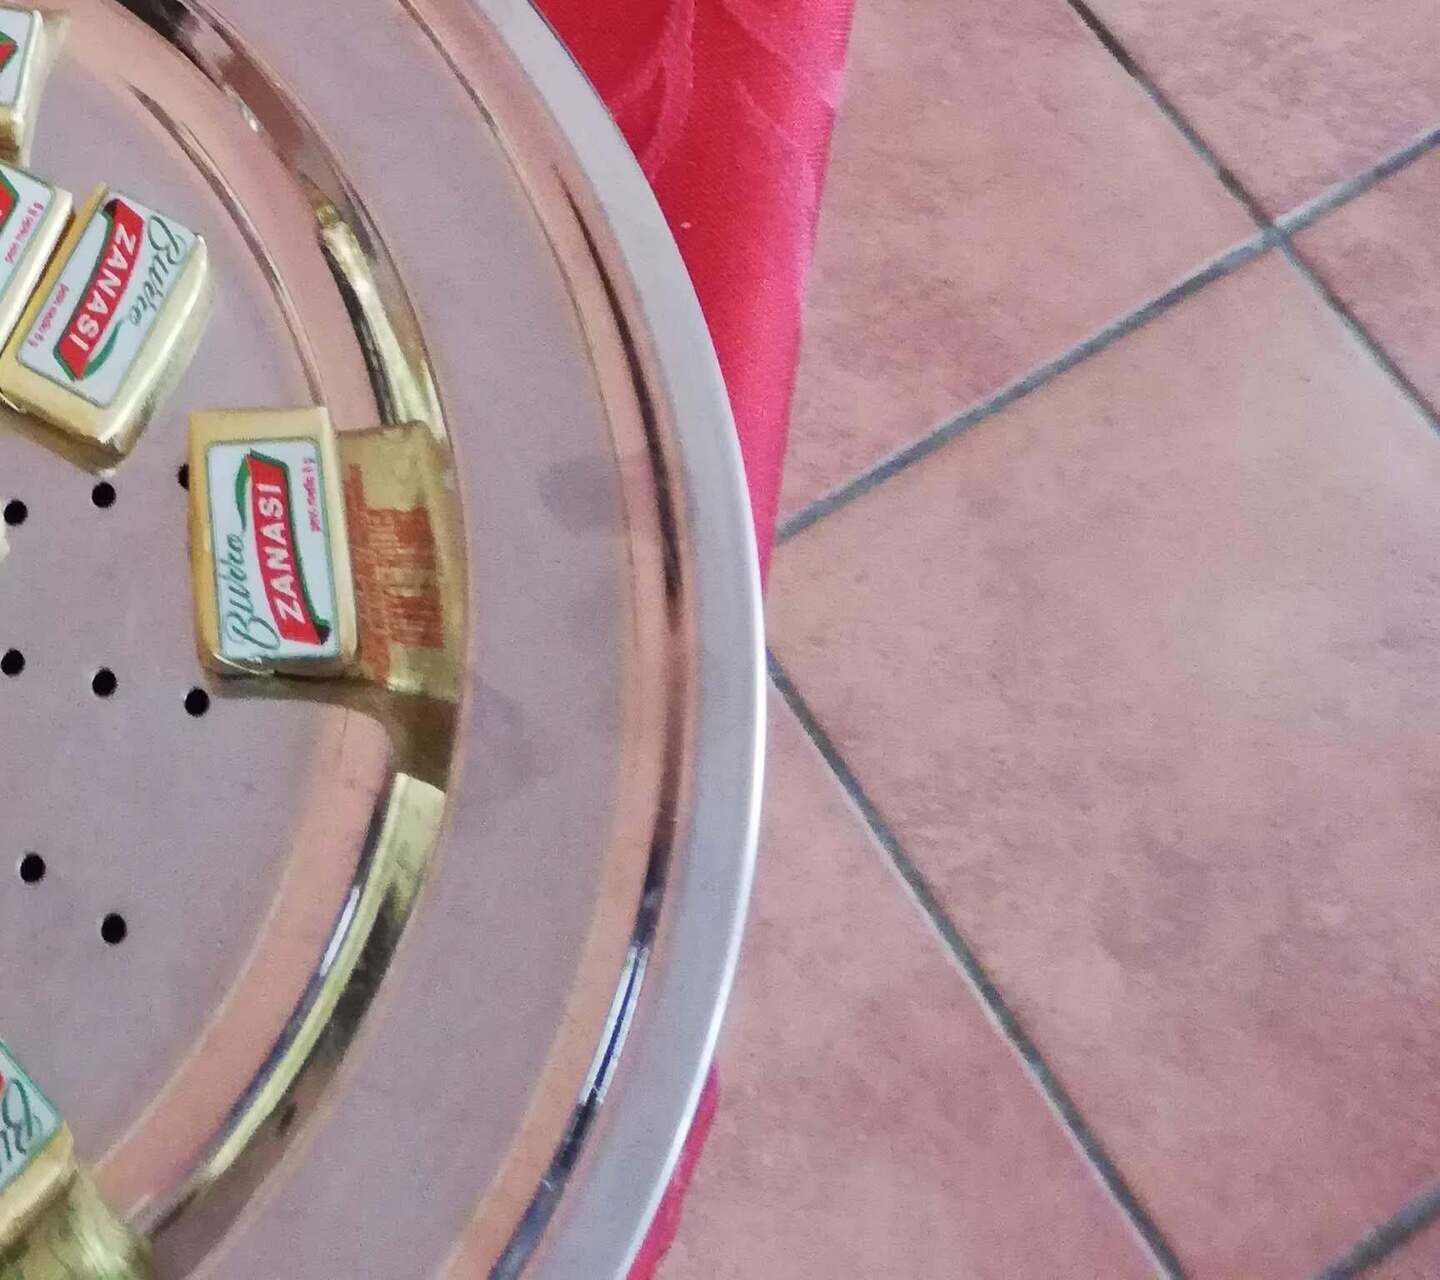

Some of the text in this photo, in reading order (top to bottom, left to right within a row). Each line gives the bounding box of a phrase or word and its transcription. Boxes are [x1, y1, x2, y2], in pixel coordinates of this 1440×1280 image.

[68, 221, 137, 351] ZANASI
[124, 215, 187, 326] Burro
[217, 532, 280, 647] Burro
[256, 483, 305, 622] ZANASI
